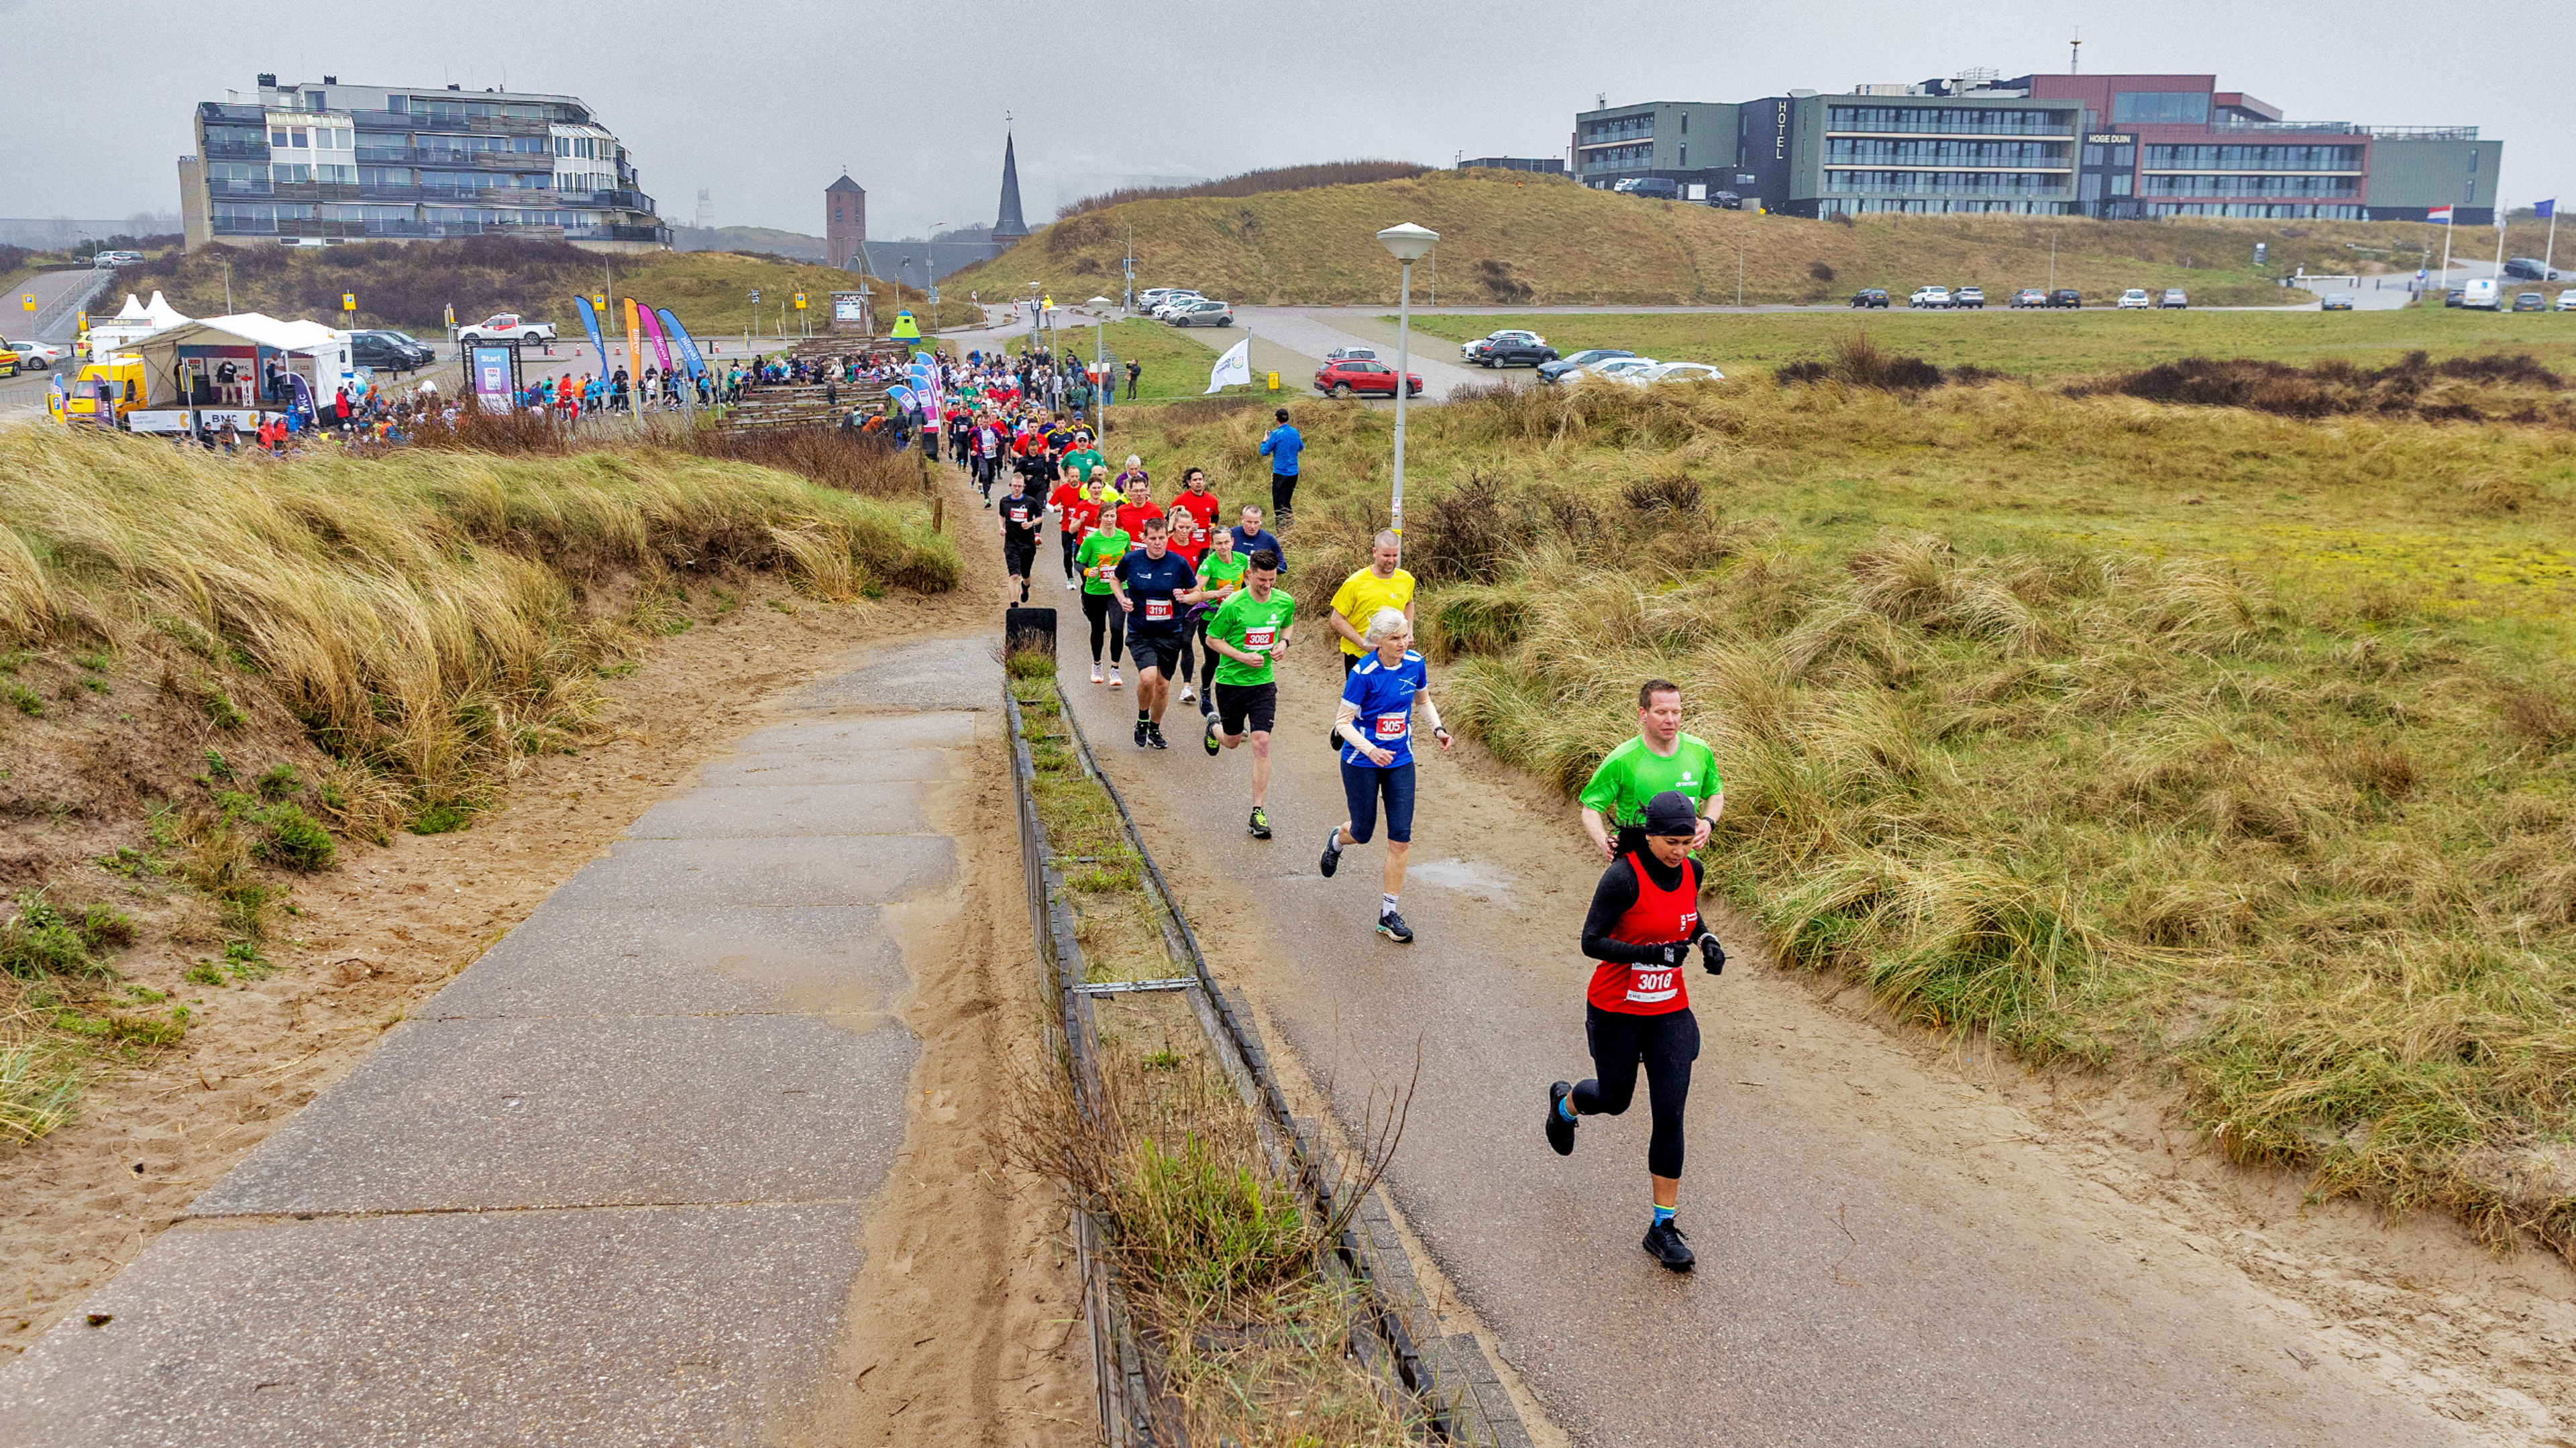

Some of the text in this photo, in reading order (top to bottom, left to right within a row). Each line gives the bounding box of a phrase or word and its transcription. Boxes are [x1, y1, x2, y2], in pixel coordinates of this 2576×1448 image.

[1776, 101, 1786, 159] HOTEL
[2088, 135, 2131, 144] HOGE DUIN
[212, 414, 237, 423] BMC
[1149, 606, 1167, 614] 3191
[1249, 634, 1270, 644] 3082
[1382, 720, 1403, 732] 305
[1638, 972, 1673, 990] 3018
